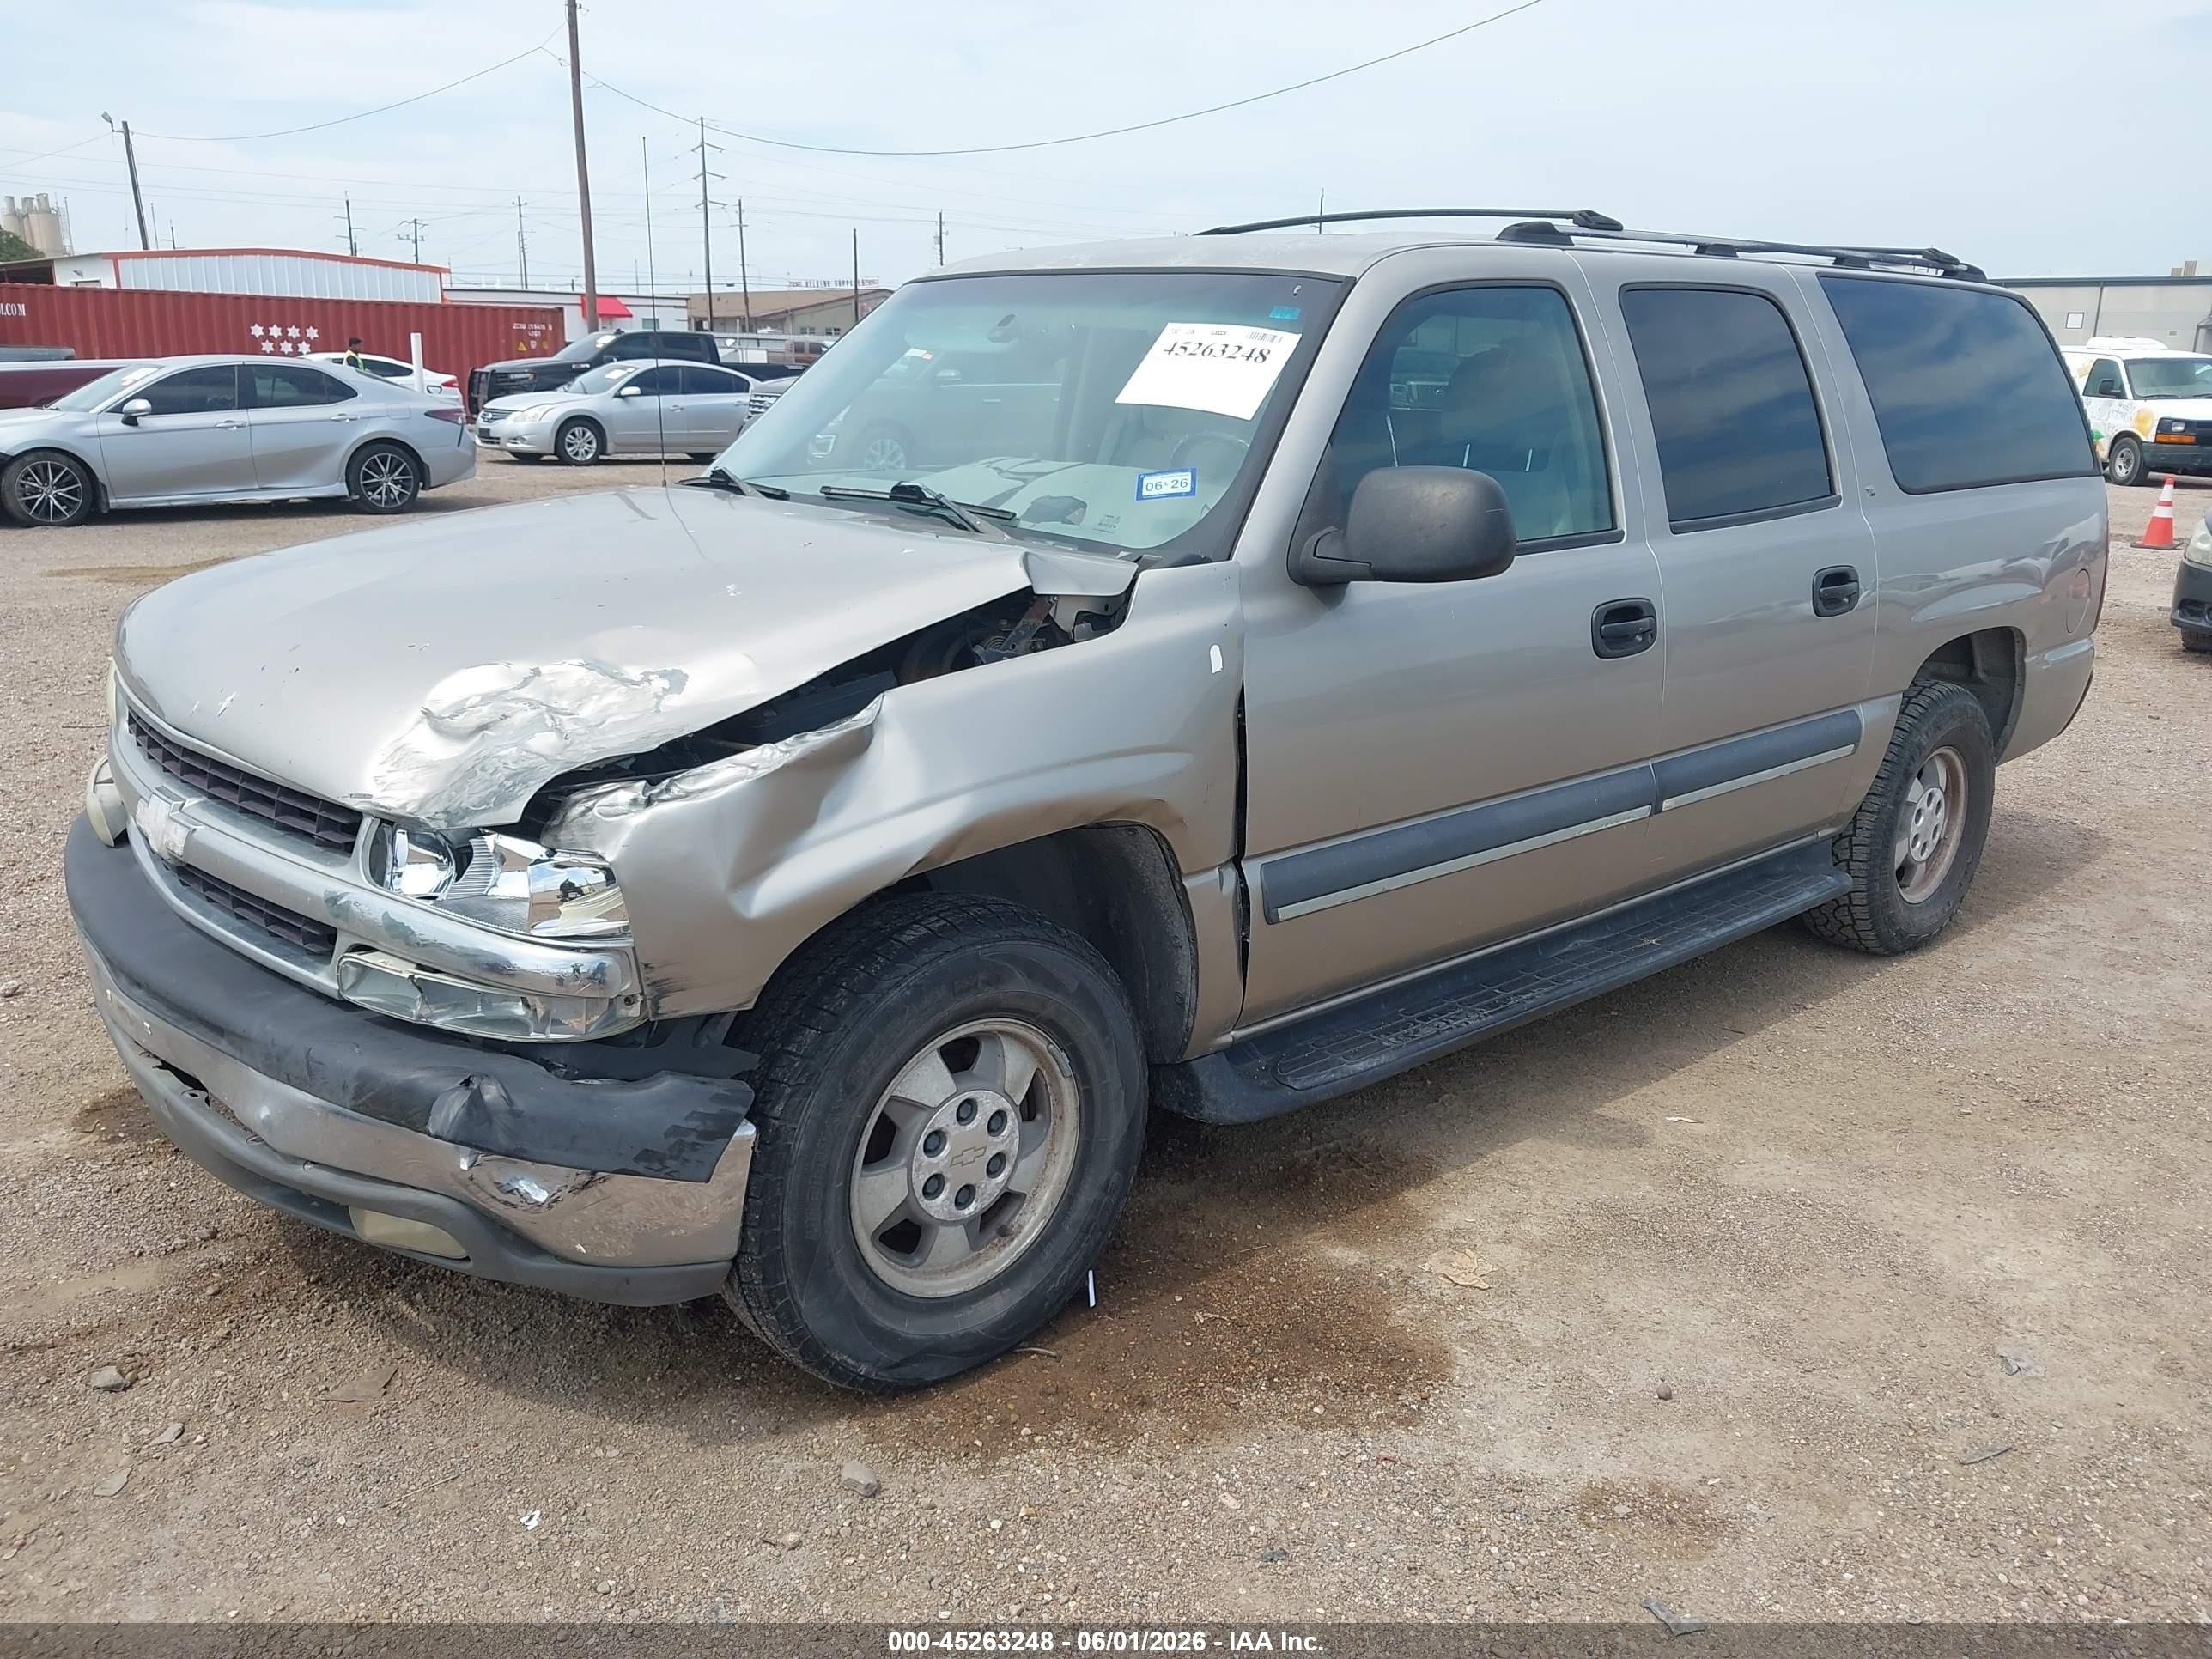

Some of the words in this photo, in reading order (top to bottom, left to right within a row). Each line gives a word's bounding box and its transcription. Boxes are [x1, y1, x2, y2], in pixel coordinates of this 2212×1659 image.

[1163, 341, 1271, 364] 45263248
[1146, 481, 1163, 492] 06
[1170, 478, 1188, 489] 26
